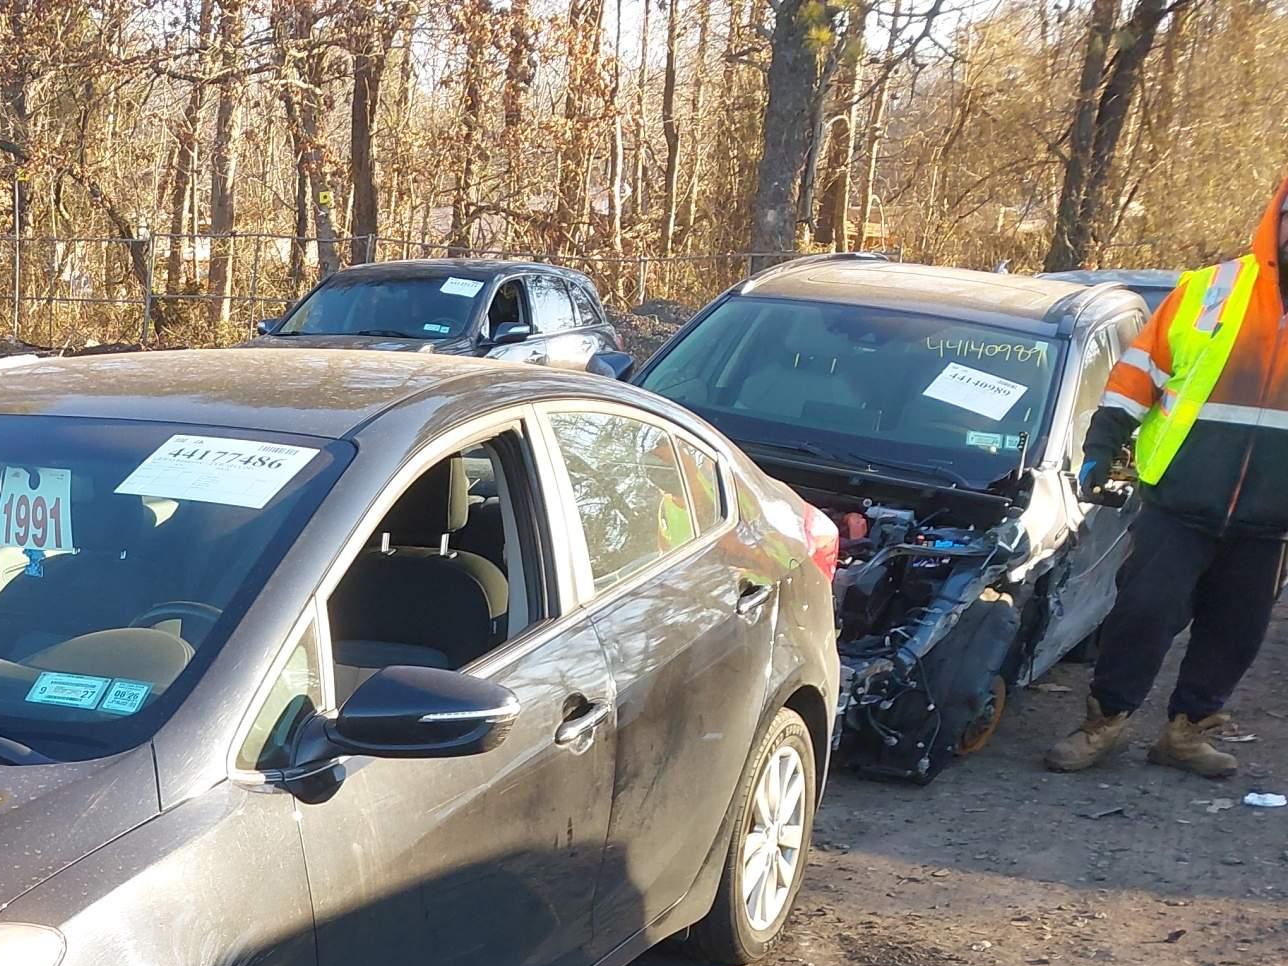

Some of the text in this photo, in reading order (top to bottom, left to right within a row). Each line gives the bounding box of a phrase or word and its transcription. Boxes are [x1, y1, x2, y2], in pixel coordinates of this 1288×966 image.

[925, 335, 1045, 369] 44140989
[950, 372, 1012, 398] 44140989
[168, 446, 289, 471] 44177486
[3, 493, 63, 549] 1991
